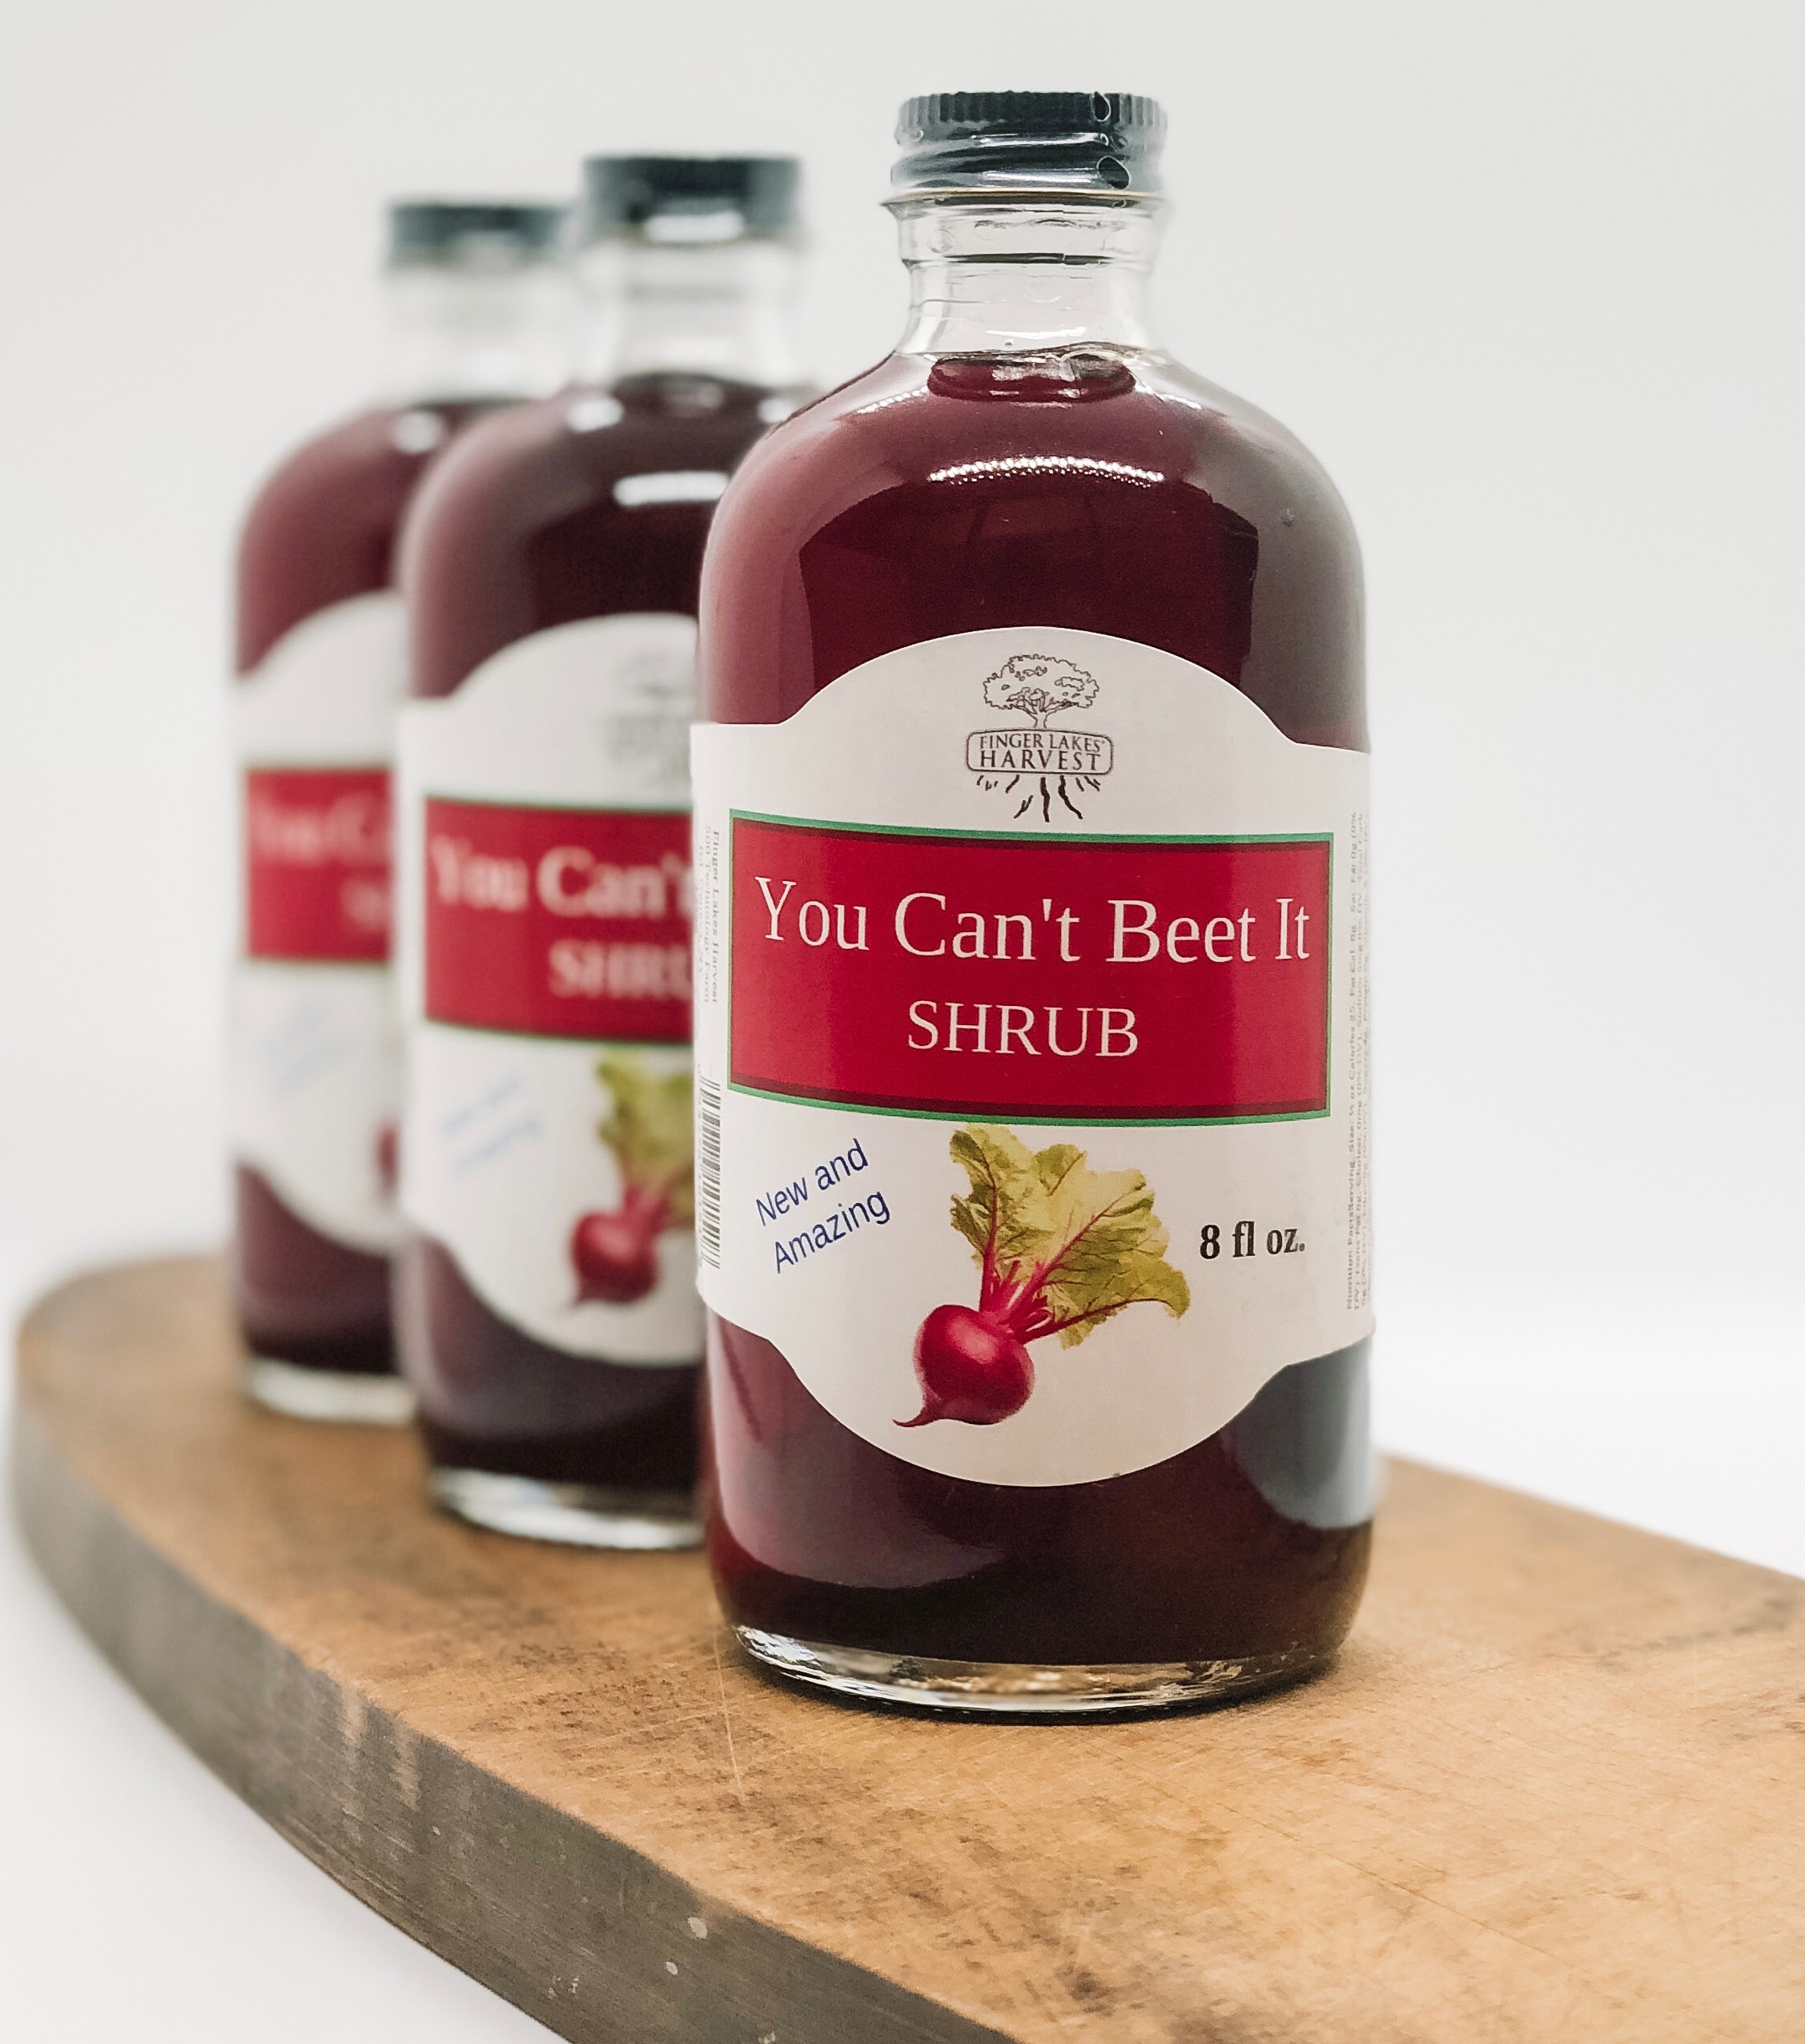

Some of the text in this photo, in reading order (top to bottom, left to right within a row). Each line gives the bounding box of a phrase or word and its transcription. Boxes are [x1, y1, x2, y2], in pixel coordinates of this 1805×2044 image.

[979, 733, 1042, 749] FINGER
[980, 749, 1100, 771] HARVEST
[754, 876, 870, 950] You
[894, 892, 1080, 963] Can't
[1105, 899, 1256, 964] Beet
[1275, 898, 1310, 960] It
[908, 1000, 1138, 1057] SHRUB
[755, 1137, 869, 1226] New and
[774, 1191, 890, 1274] Amazing
[1200, 1224, 1220, 1260] 8
[1232, 1220, 1256, 1258] fl
